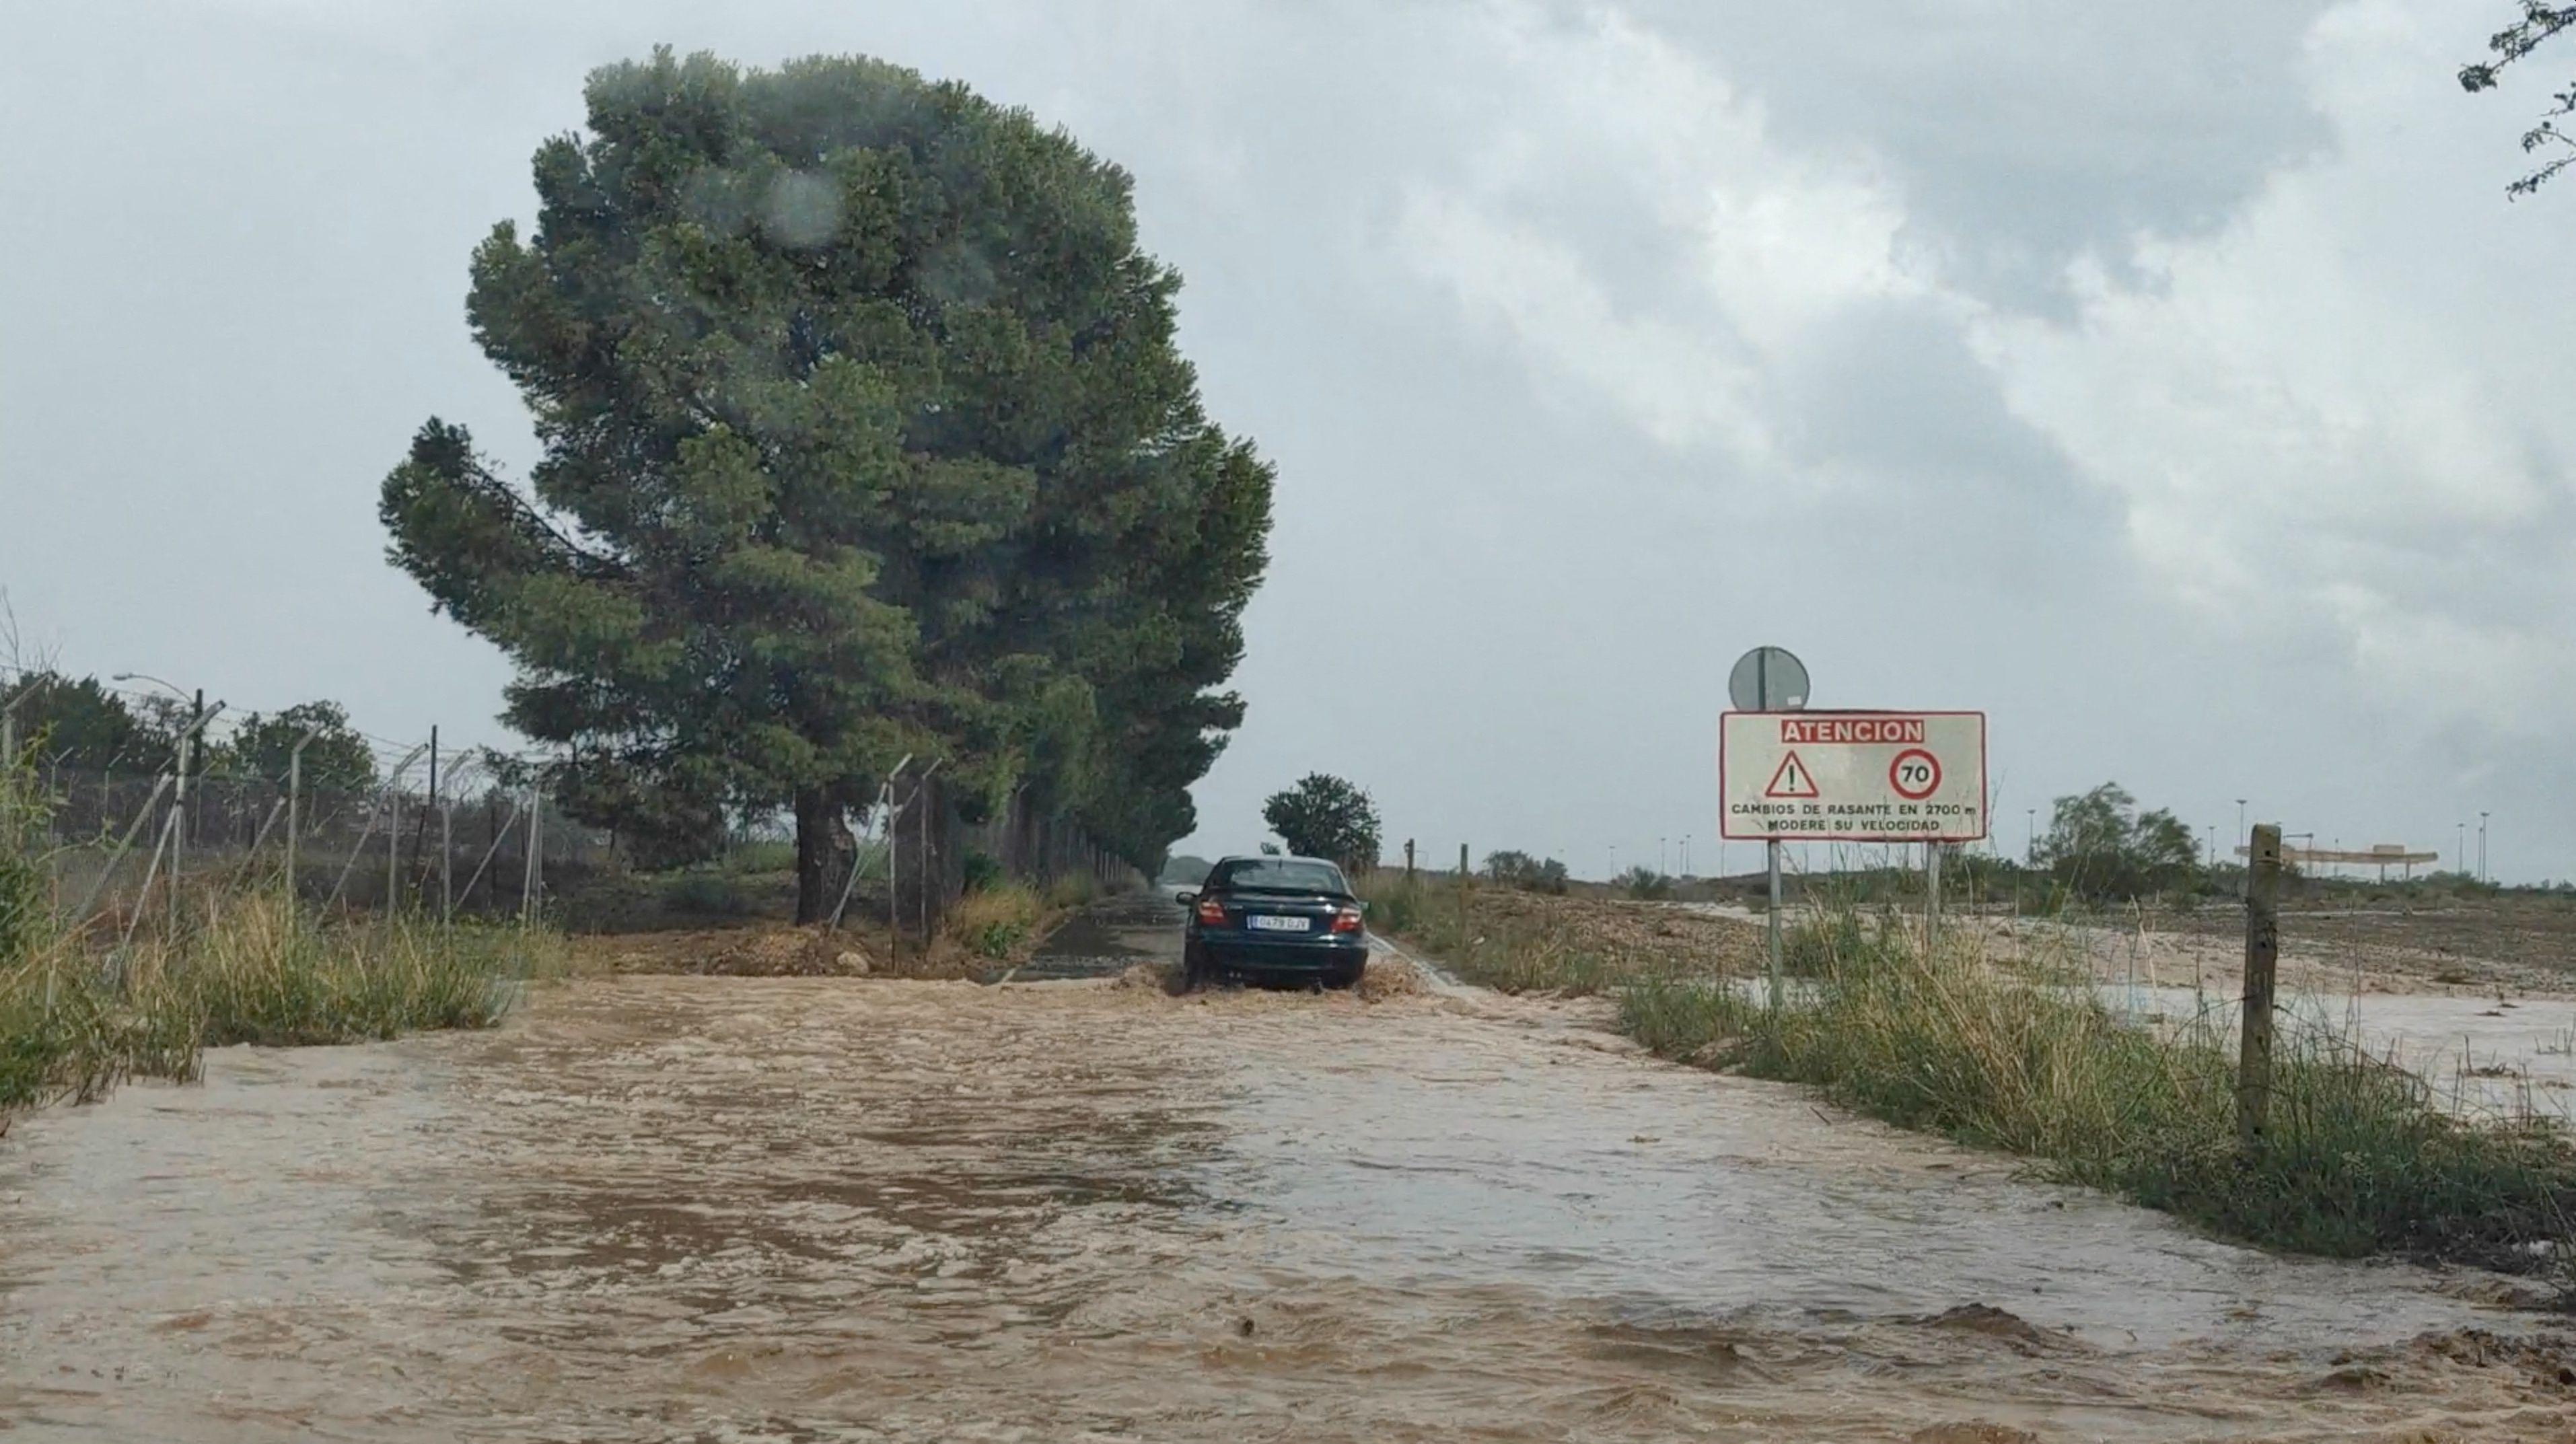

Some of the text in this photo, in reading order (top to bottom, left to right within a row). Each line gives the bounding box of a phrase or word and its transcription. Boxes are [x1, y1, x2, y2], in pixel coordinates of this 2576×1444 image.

[1784, 722, 1923, 741] ATENCION
[1900, 766, 1929, 783] 70
[1731, 804, 1976, 815] CAMBIOS DE RASANTE EN 2700 m
[1768, 820, 1939, 831] MODERE SU VELOCIDAD
